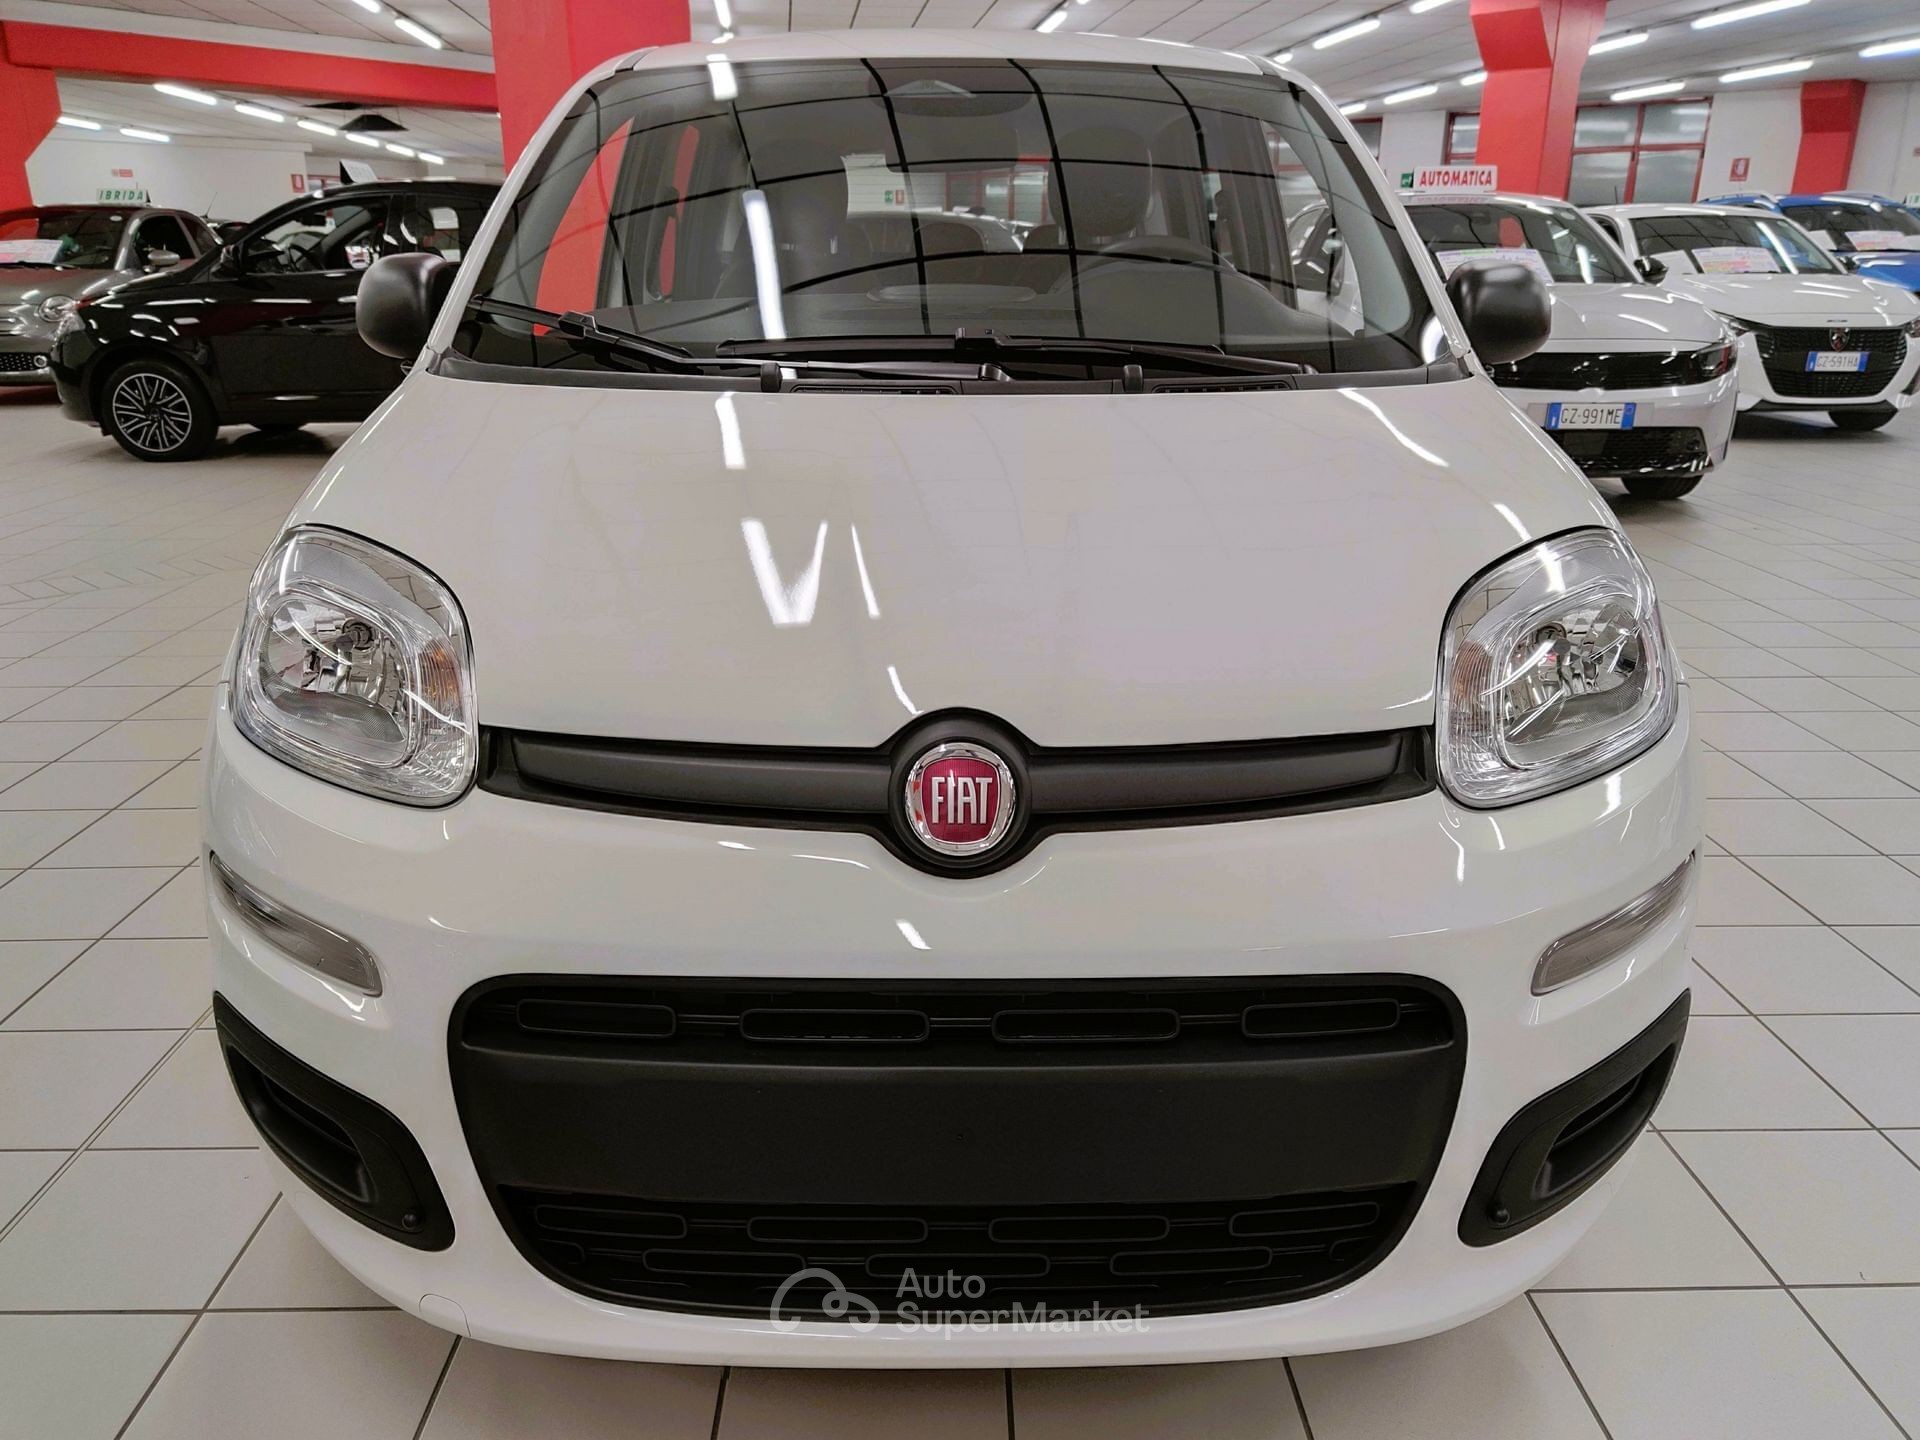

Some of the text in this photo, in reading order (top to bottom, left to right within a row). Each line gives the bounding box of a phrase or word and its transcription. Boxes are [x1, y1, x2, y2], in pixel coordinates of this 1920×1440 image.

[1420, 170, 1492, 186] AUTOMATICA
[100, 190, 143, 200] IBRIDA
[931, 776, 992, 824] FIAT
